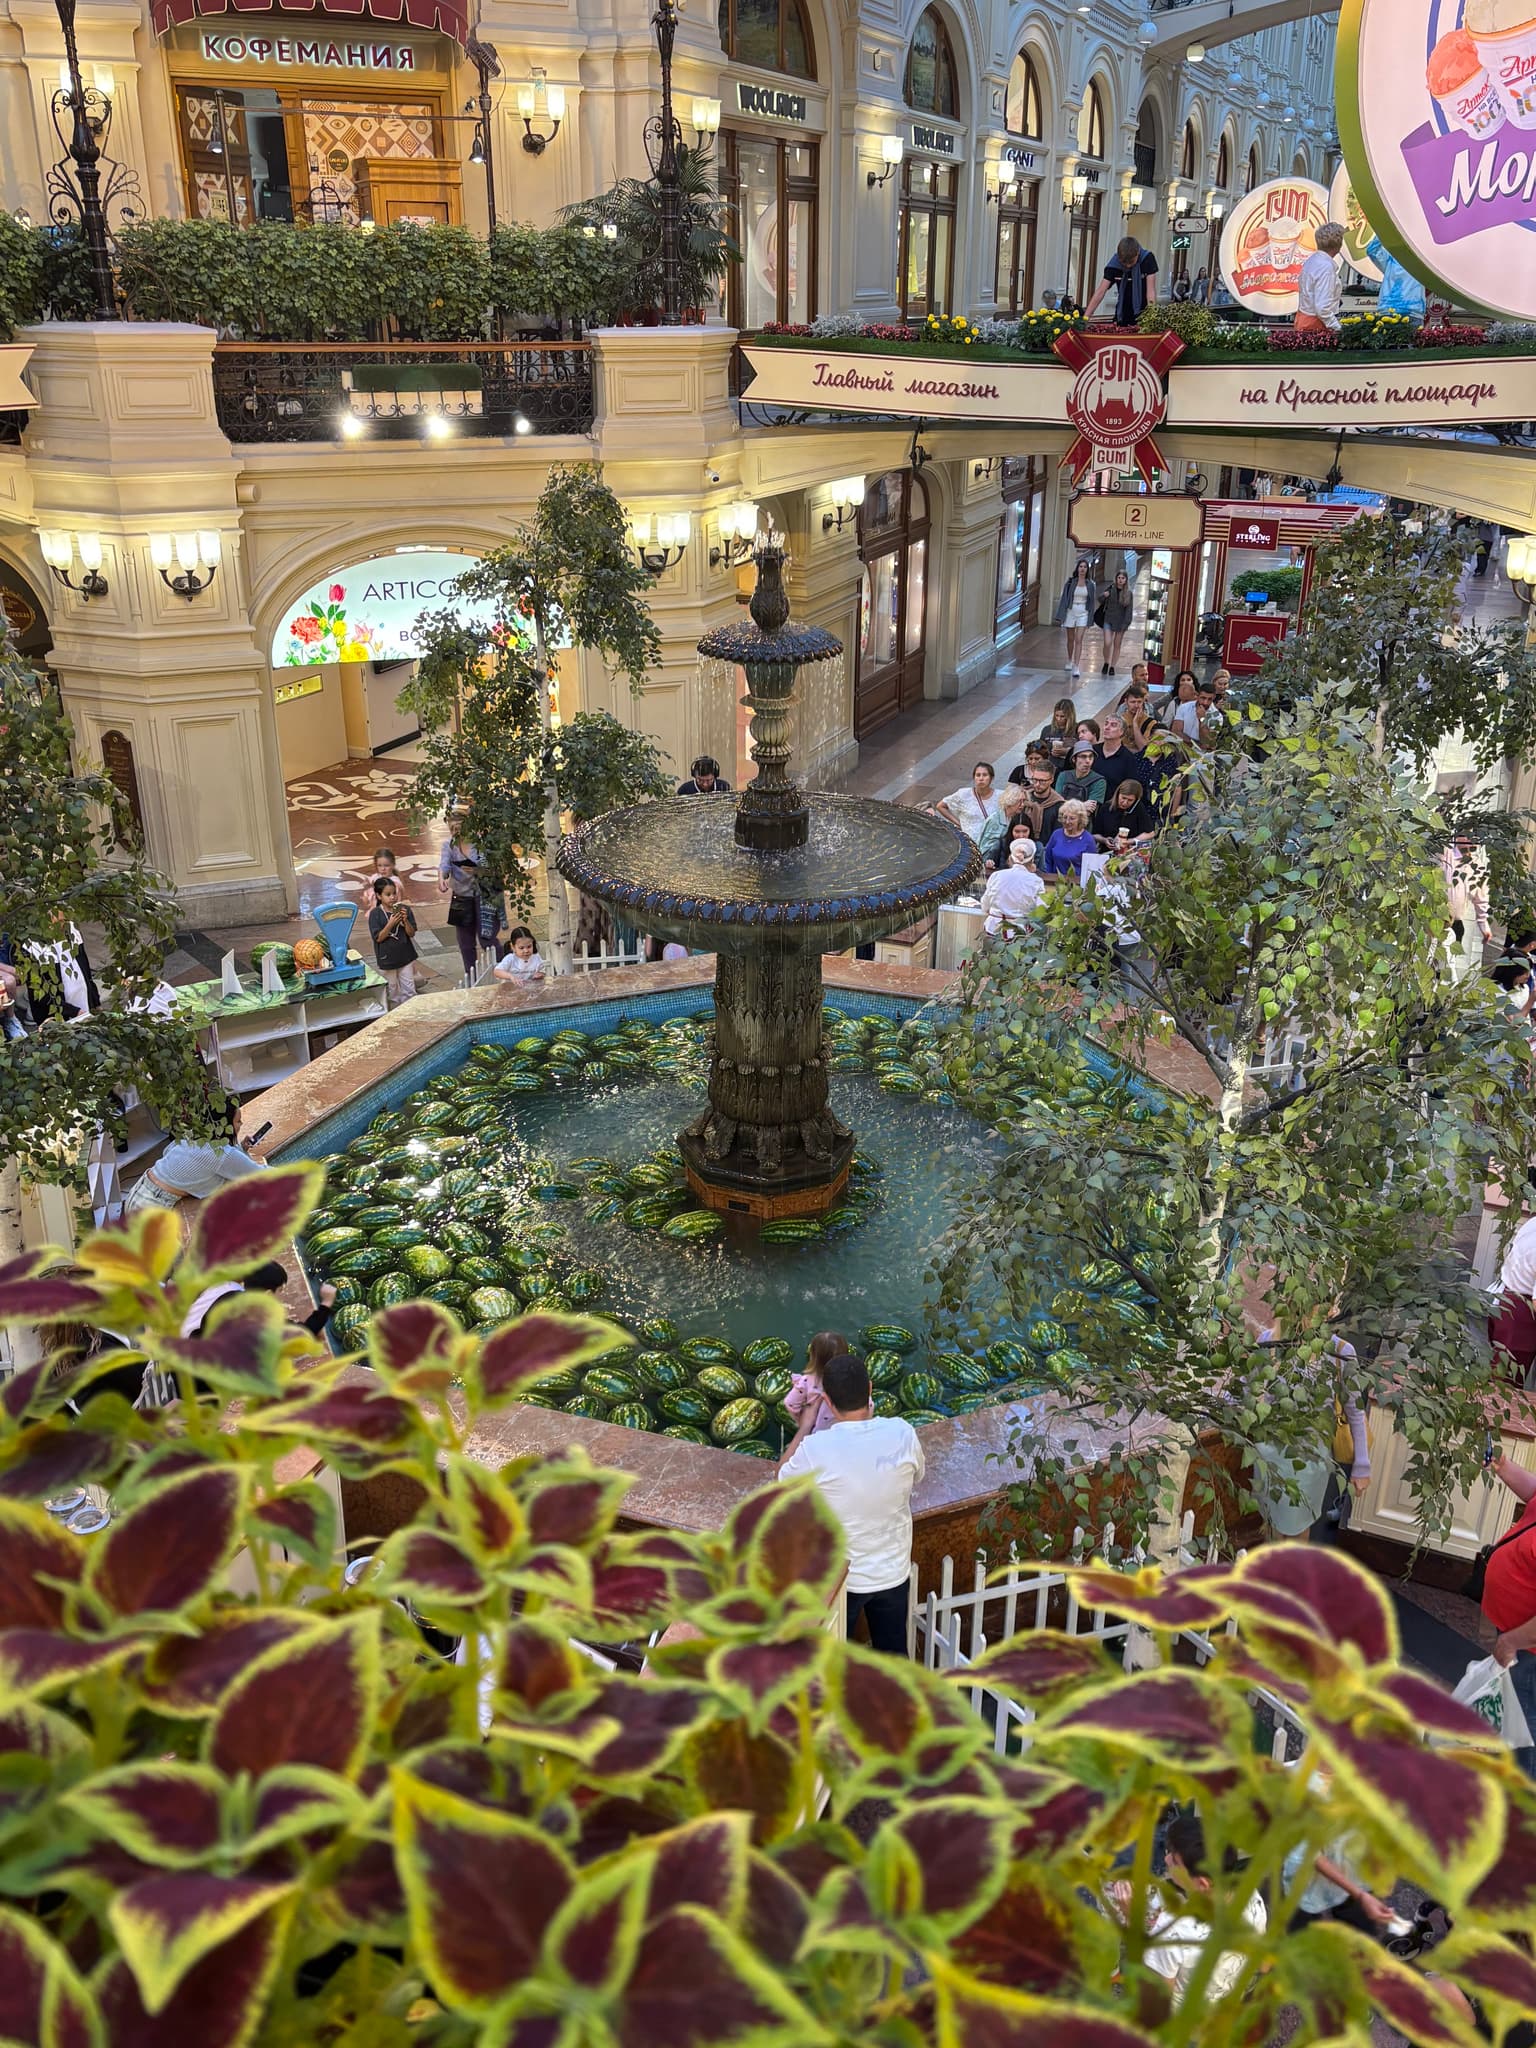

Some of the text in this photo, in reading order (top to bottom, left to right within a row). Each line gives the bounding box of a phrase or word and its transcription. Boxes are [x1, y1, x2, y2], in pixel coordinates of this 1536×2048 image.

[203, 35, 415, 70] КОФЕМАНИЯ
[737, 82, 806, 121] WOOLRICH
[912, 124, 954, 154] WOOLRICH
[1006, 147, 1034, 169] GANT
[1265, 188, 1310, 224] ГУМ
[812, 362, 1000, 400] Главный магазин
[1097, 349, 1139, 382] ГУМ
[1239, 378, 1497, 413] на Красной площади
[1077, 416, 1152, 446] КРАСНАЯ ПЛОЩАДЬ
[1097, 449, 1127, 465] GUM
[1130, 508, 1141, 522] 2
[1104, 529, 1165, 540] ЛИНИЯ LINE
